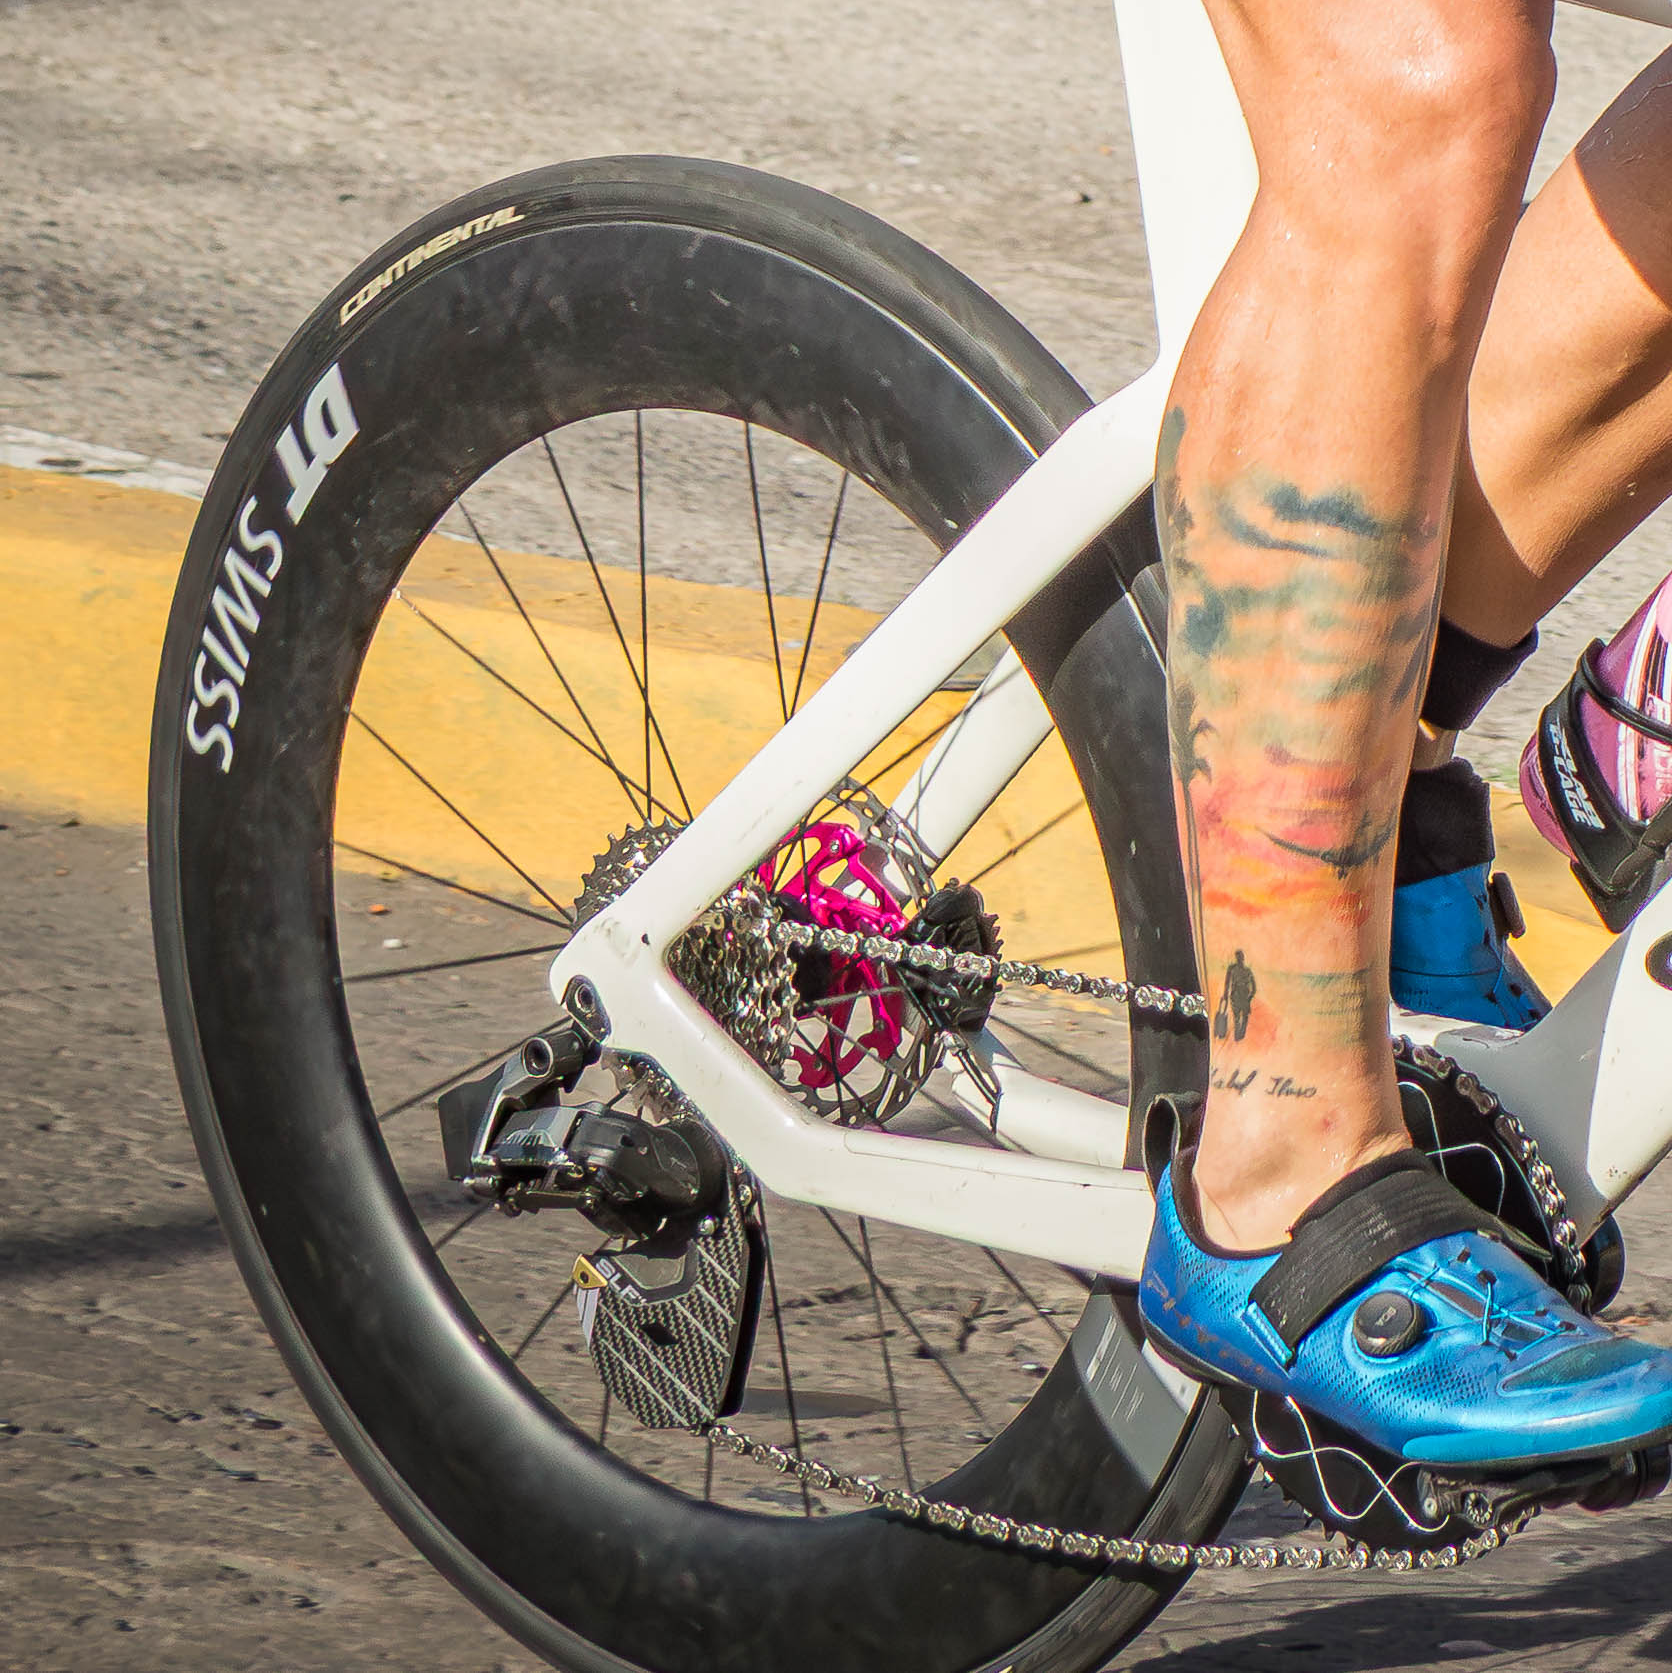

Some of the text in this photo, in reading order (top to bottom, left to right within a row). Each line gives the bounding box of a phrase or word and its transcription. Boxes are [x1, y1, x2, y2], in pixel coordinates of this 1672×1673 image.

[340, 206, 525, 326] CONTINENTAL
[185, 361, 361, 774] DT SWISS
